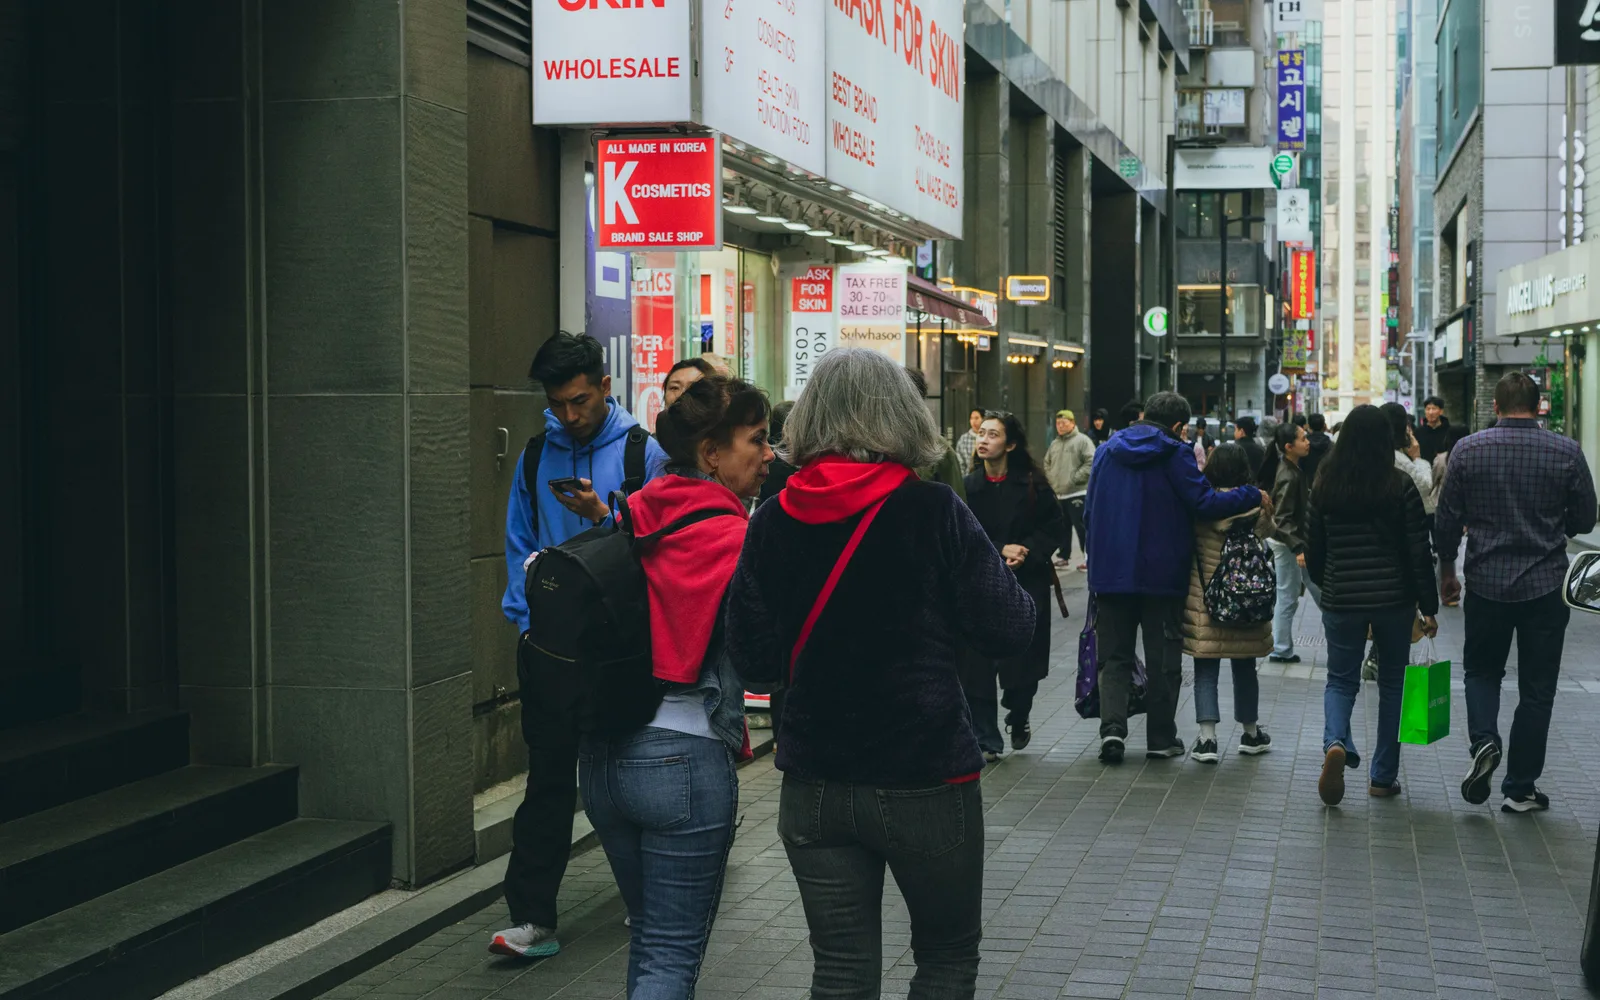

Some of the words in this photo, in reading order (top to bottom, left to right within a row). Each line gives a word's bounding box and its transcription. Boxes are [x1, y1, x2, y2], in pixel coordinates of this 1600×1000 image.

[758, 17, 796, 63] COSMETICS
[893, 0, 924, 76] FOR
[929, 19, 959, 103] SKIN
[543, 57, 680, 80] WHOLESALE
[725, 46, 735, 73] 3F
[758, 67, 783, 101] HEALTH
[785, 83, 800, 112] SKIN
[832, 70, 852, 109] BEST
[854, 84, 878, 124] BRAND
[758, 98, 791, 137] FUNCTION
[793, 116, 811, 146] FOOD
[606, 143, 626, 154] ALL
[628, 142, 656, 154] MADE
[660, 142, 671, 153] IN
[673, 142, 707, 153] KOREA
[832, 118, 876, 168] WHOLESALE
[937, 139, 950, 168] SALE
[603, 160, 640, 225] K
[631, 183, 711, 198] COSMETICS
[611, 232, 645, 243] BRAND
[648, 231, 674, 242] SALE
[676, 231, 704, 242] SHOP
[796, 268, 831, 281] ASK
[846, 277, 866, 288] TAX
[869, 277, 898, 288] FREE
[800, 283, 825, 296] FOR
[1507, 273, 1554, 316] ANGELINUS
[798, 298, 827, 311] SKIN
[840, 305, 868, 316] SALE
[872, 305, 902, 316] SHOP
[840, 327, 902, 341] Sulwhasoo
